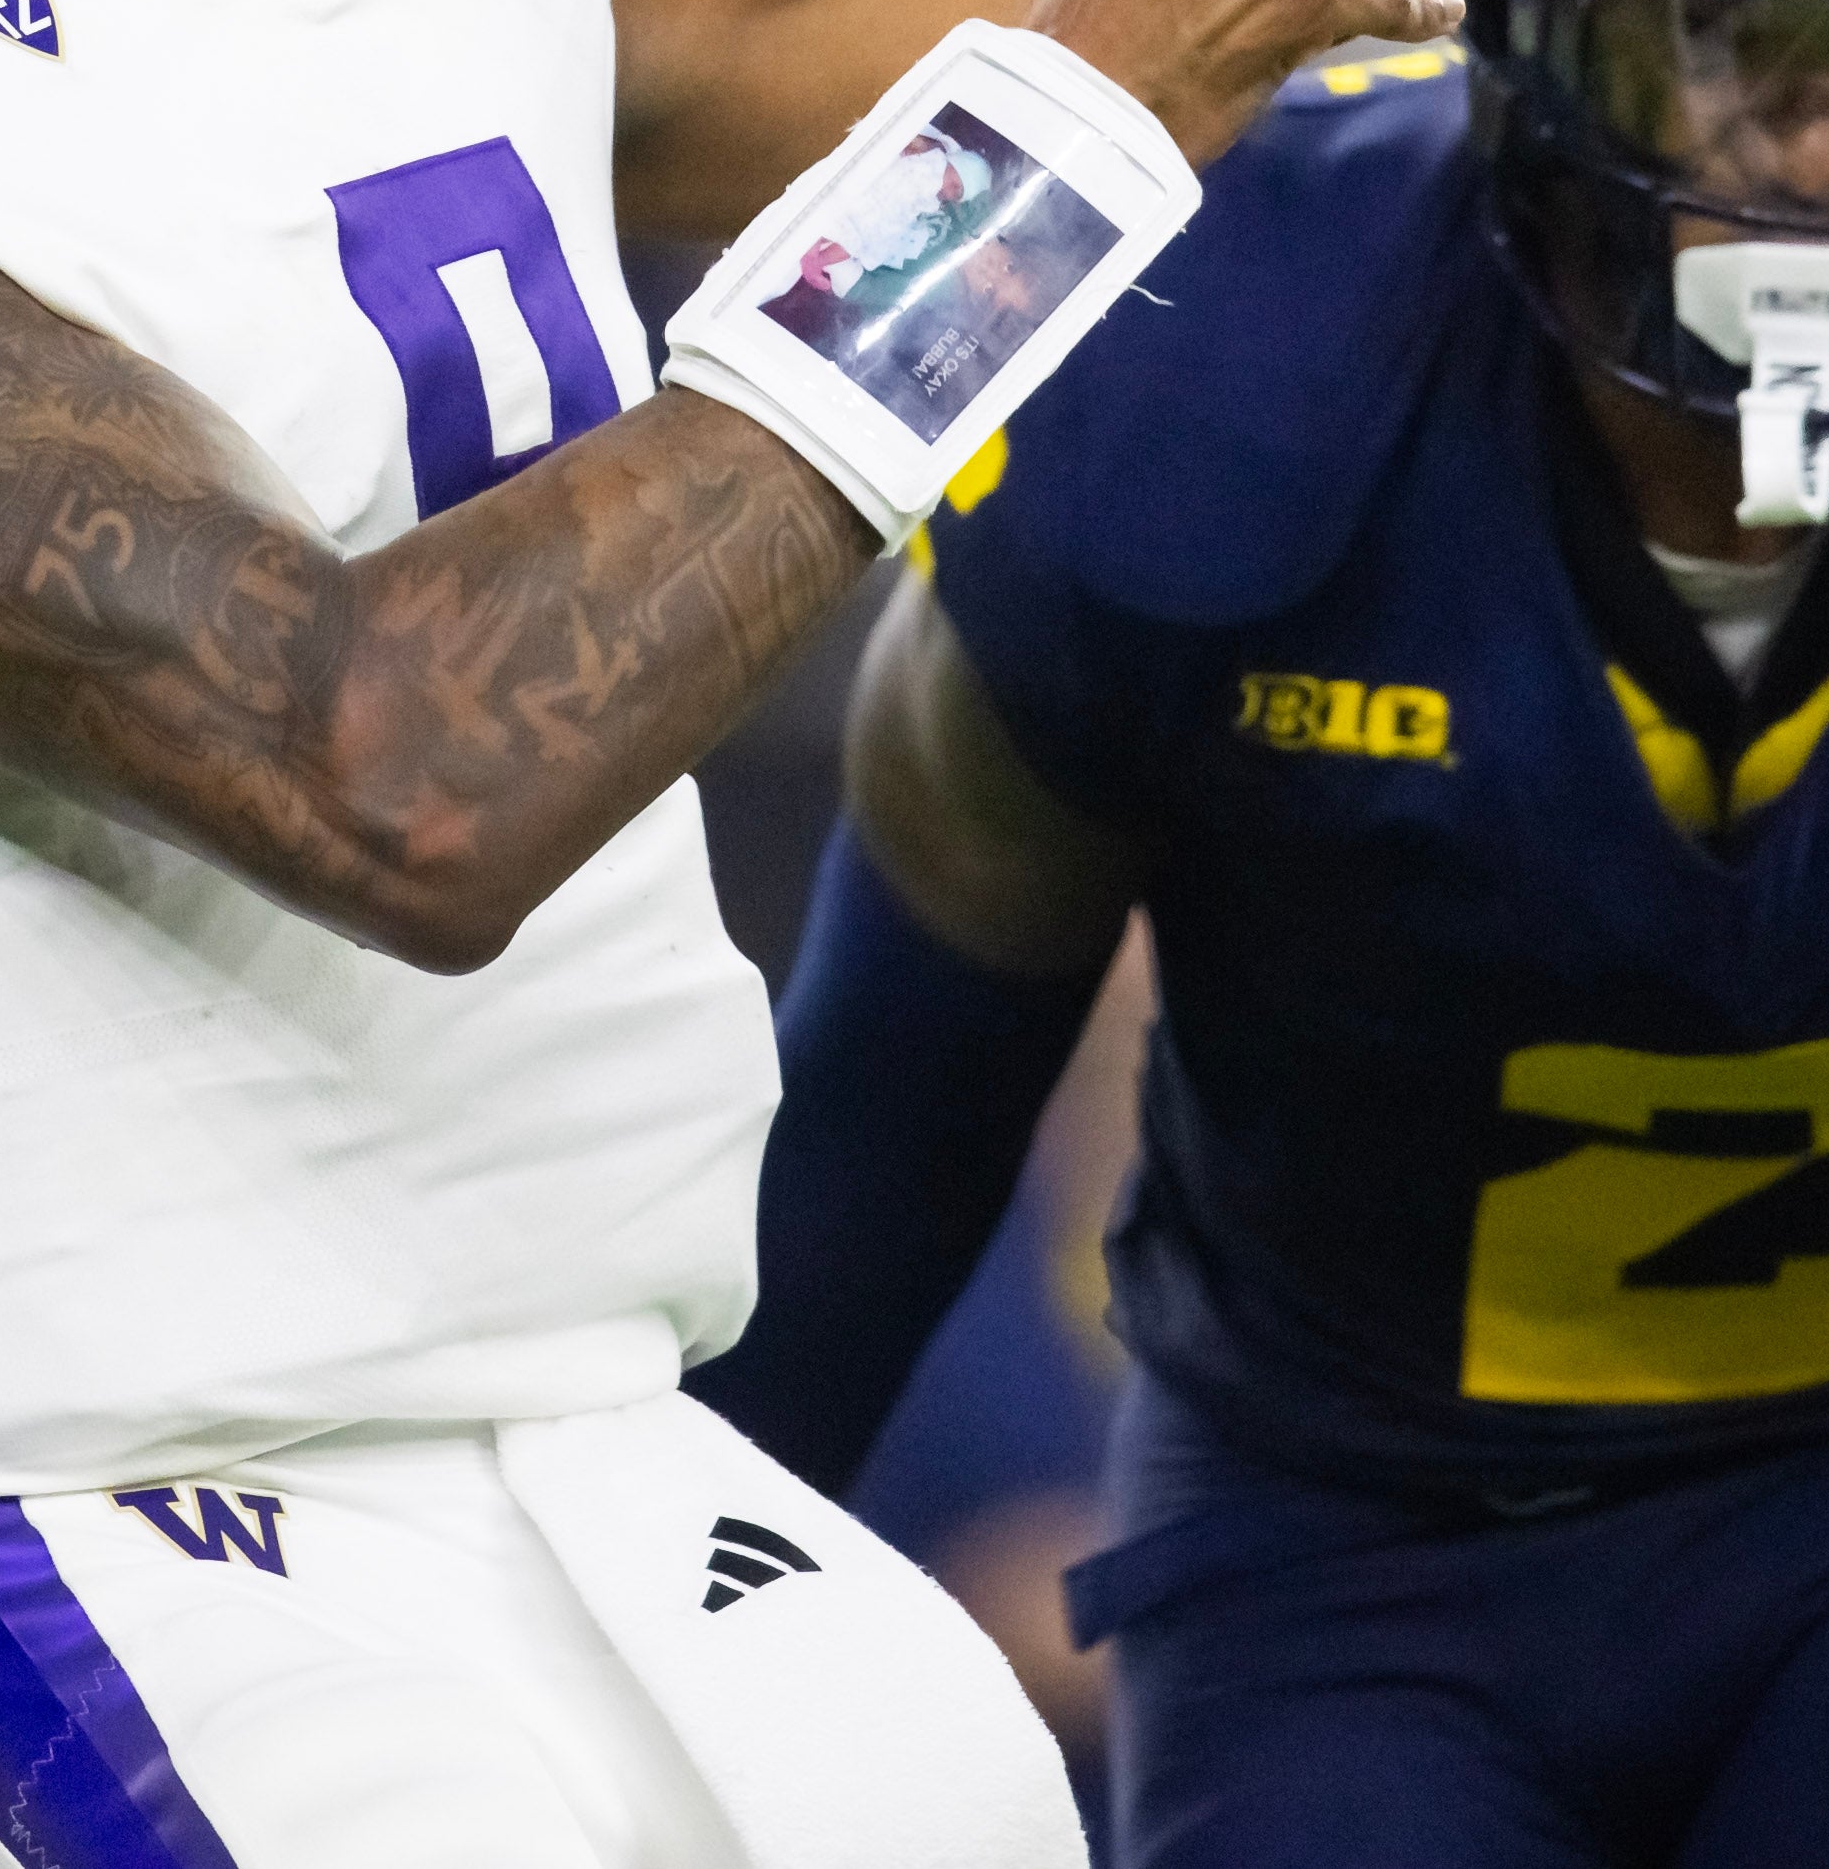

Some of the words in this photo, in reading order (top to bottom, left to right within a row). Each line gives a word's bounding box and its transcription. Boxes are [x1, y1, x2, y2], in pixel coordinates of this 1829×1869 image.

[911, 327, 960, 380] BUBBA!
[955, 334, 979, 360] ITS
[924, 357, 959, 398] OKAY
[24, 490, 136, 627] 75
[106, 1483, 292, 1580] W
